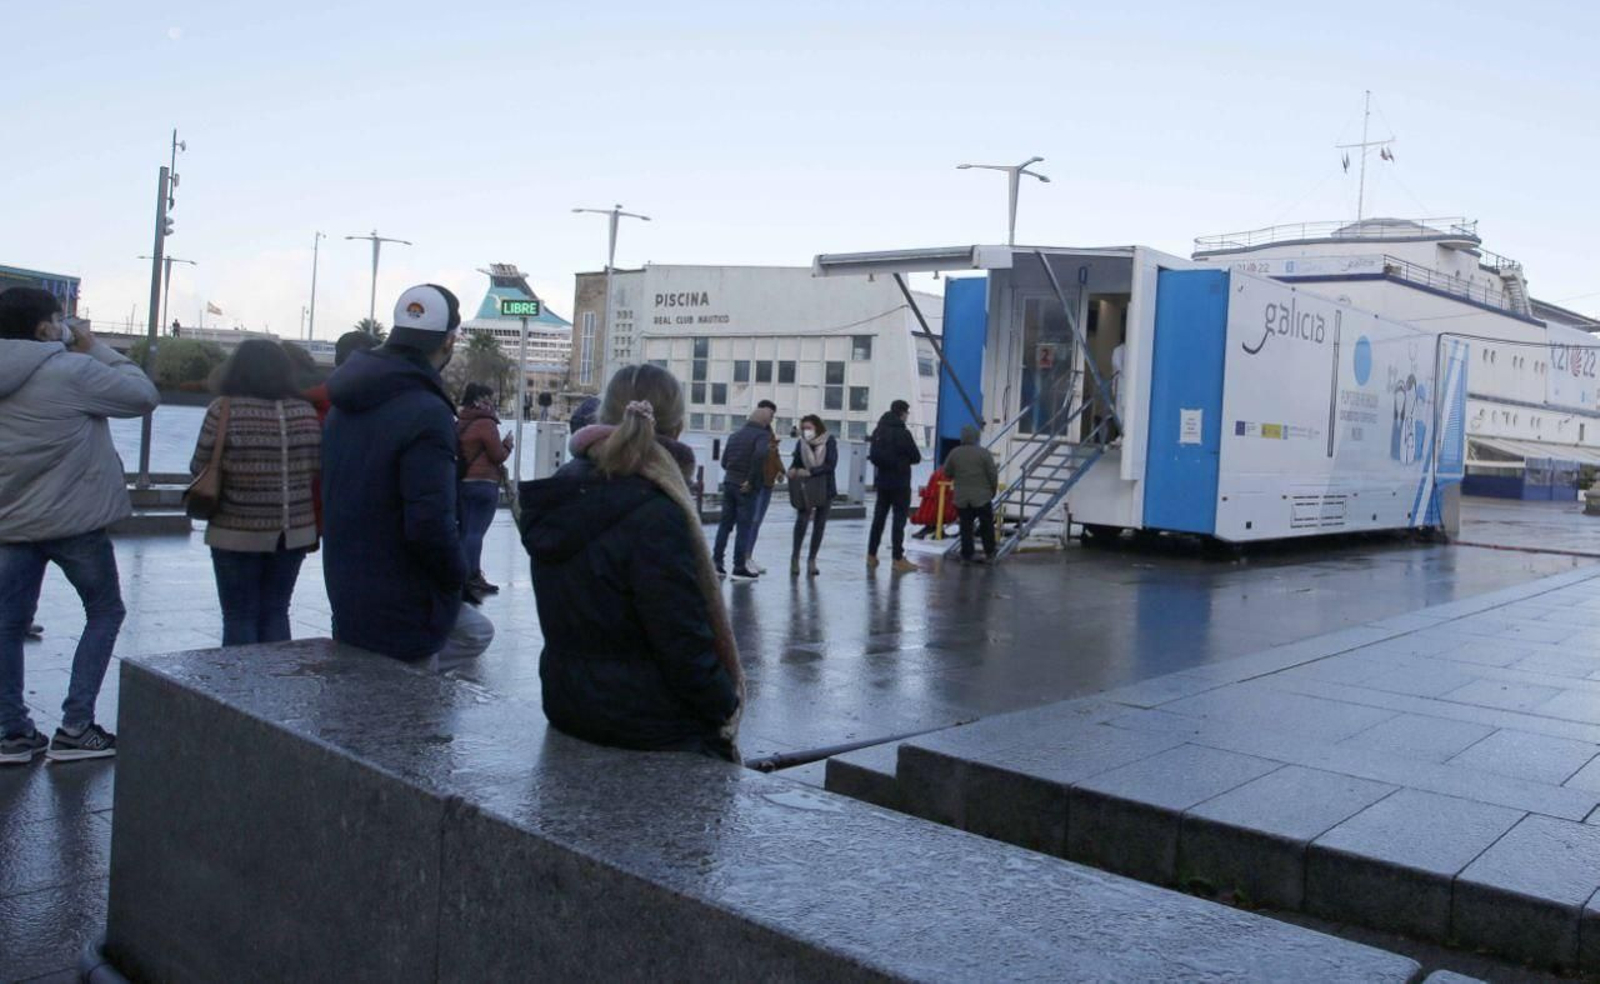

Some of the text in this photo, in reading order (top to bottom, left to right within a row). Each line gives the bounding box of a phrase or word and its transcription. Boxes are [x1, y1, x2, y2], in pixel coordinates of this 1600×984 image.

[655, 291, 710, 308] PISCINA
[503, 302, 537, 315] LIBRE
[653, 315, 671, 325] REAL
[675, 315, 694, 325] CLUB
[1241, 297, 1325, 355] galicia
[1583, 347, 1596, 378] 22
